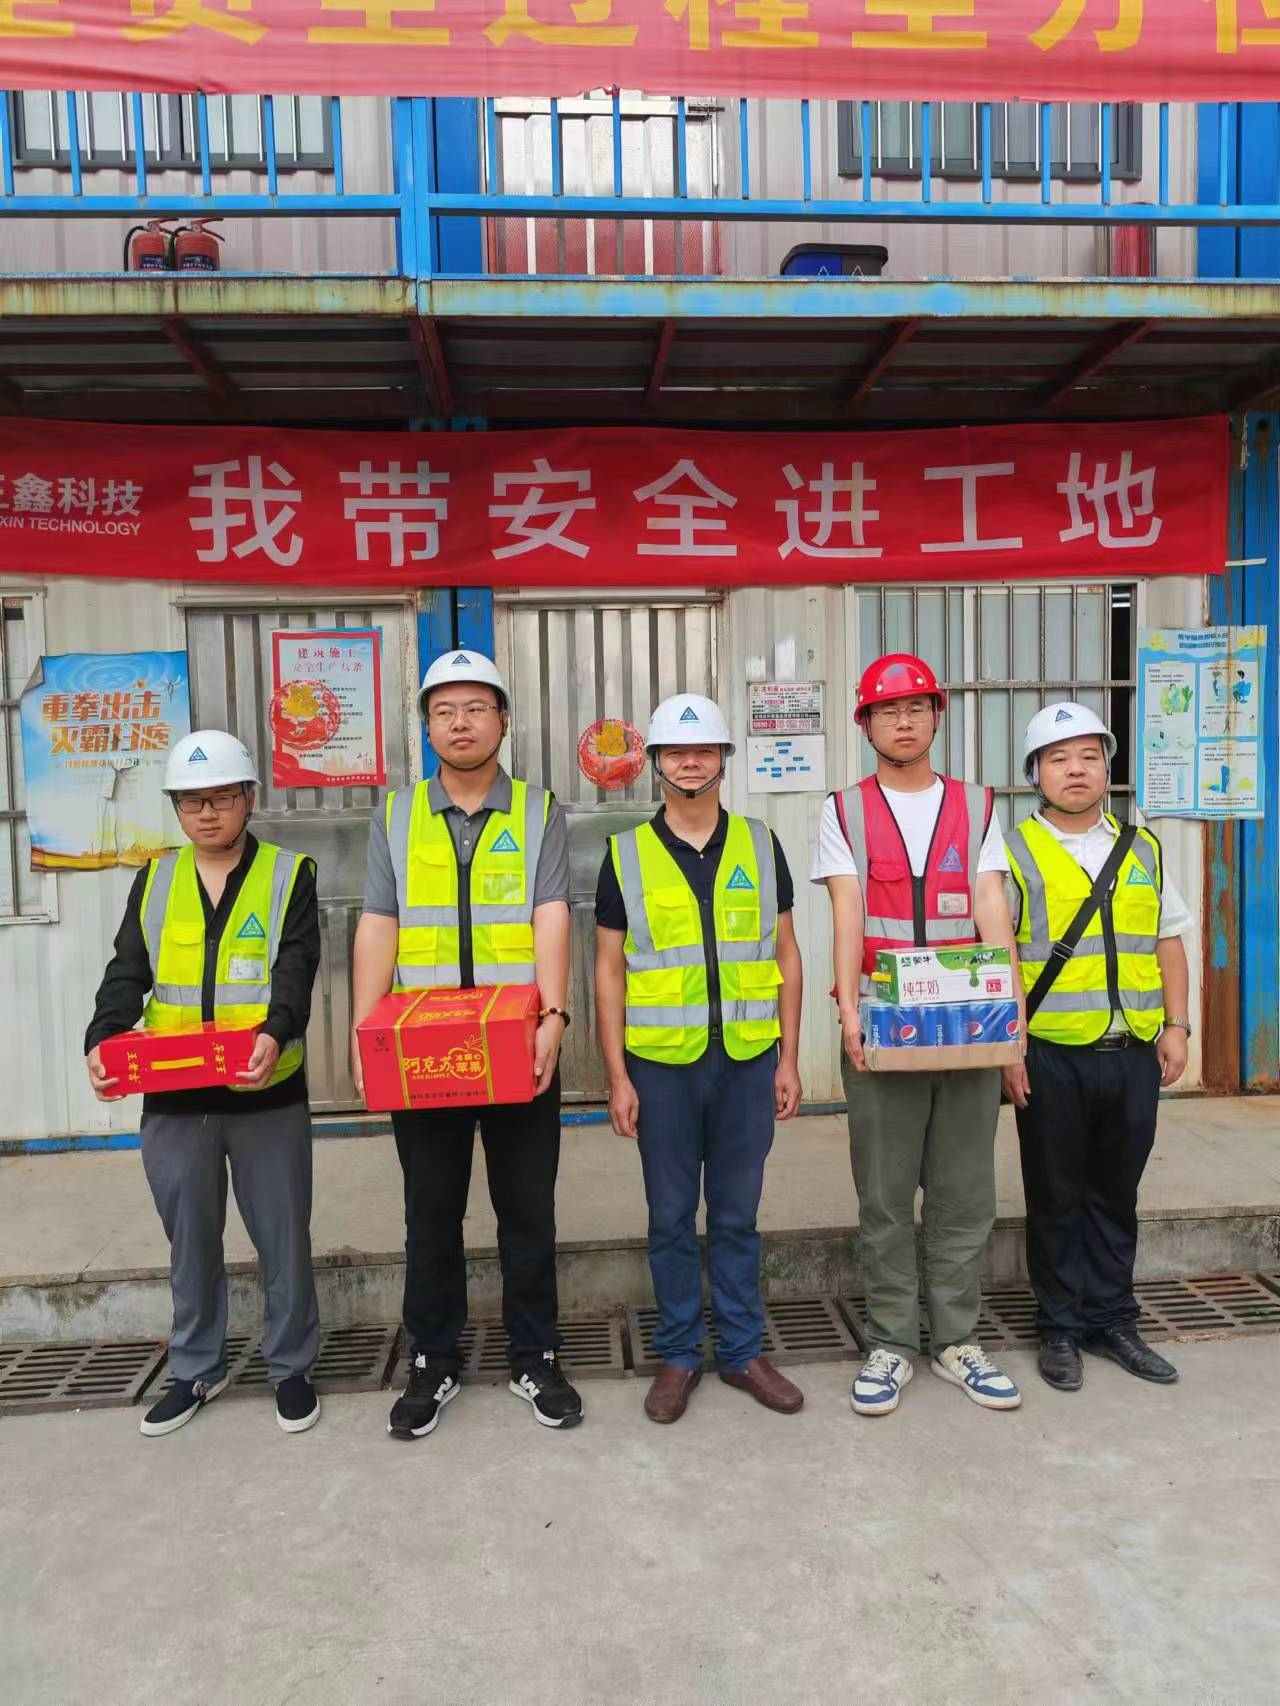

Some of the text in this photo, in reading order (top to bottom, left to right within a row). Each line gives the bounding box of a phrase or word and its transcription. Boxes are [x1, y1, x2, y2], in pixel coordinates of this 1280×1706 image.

[0, 472, 143, 517] 鑫科技
[188, 451, 1163, 567] 我带安全进工地
[29, 517, 141, 536] TECHNOLOGY
[42, 689, 161, 721] 重拳出击
